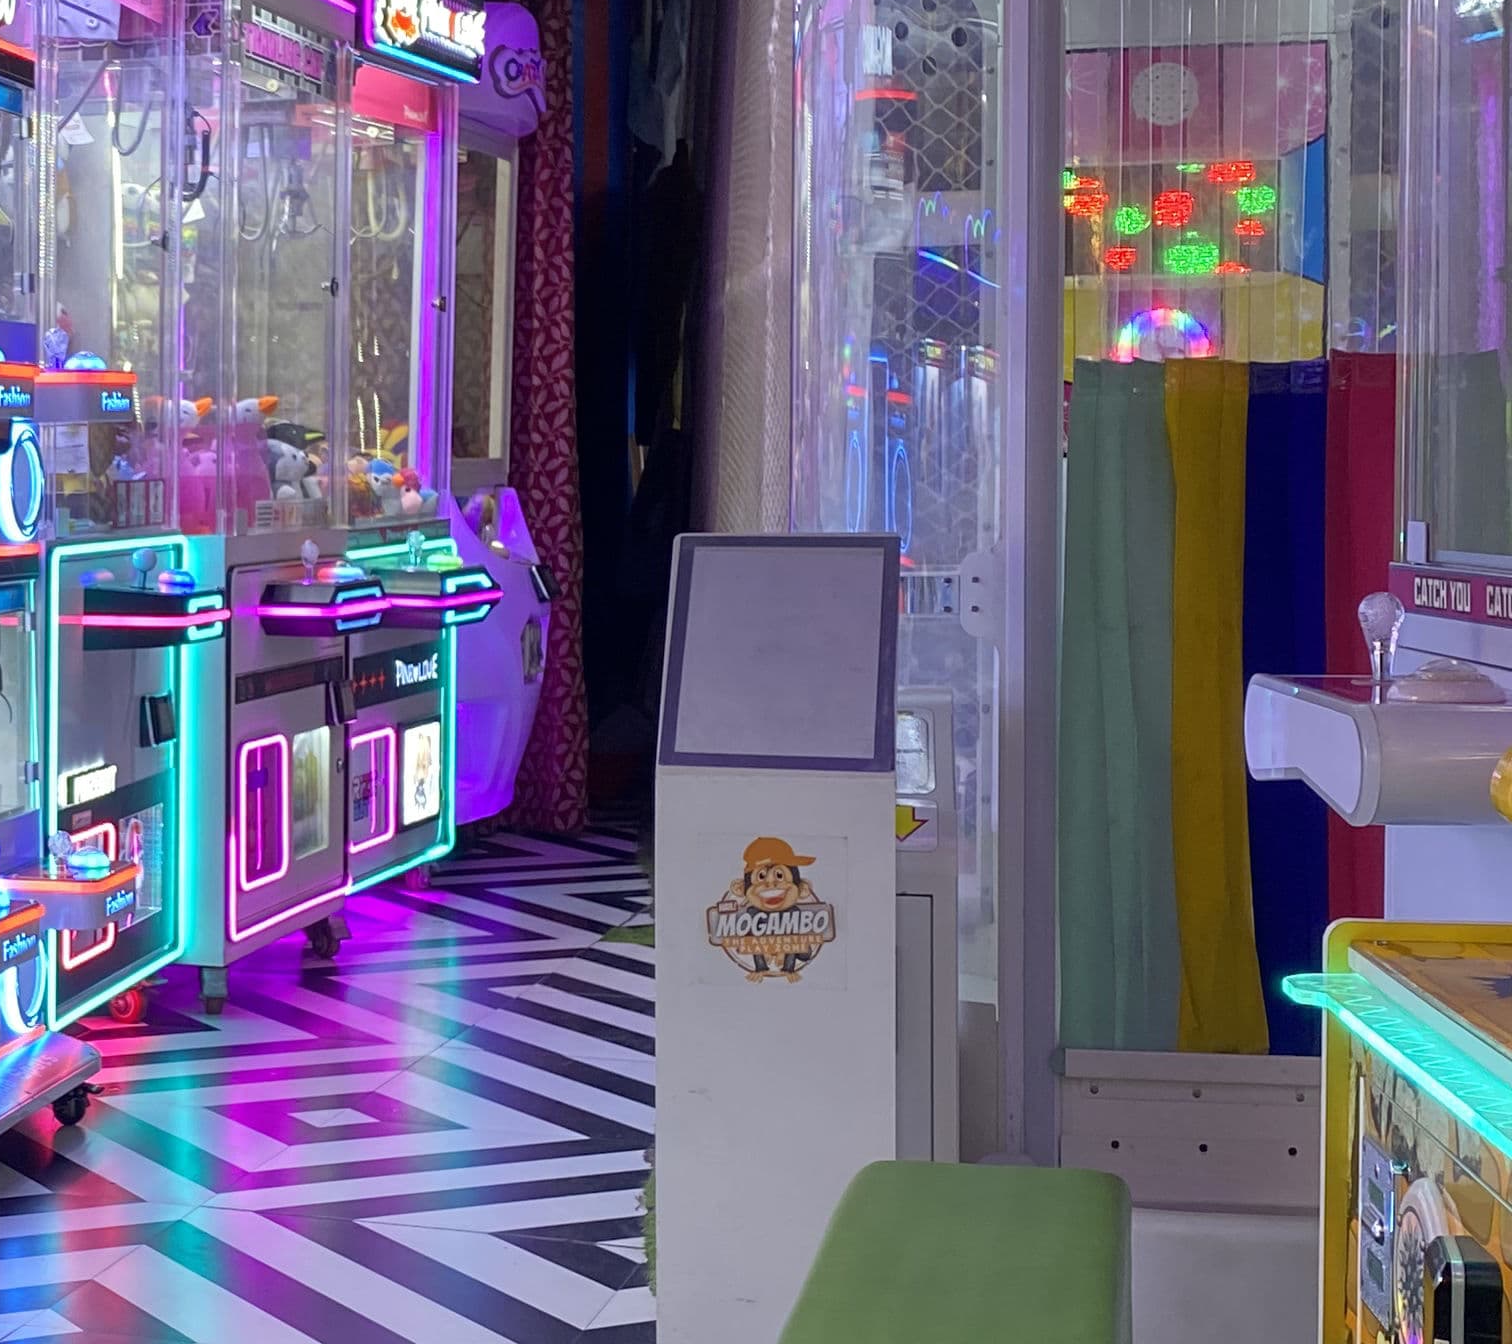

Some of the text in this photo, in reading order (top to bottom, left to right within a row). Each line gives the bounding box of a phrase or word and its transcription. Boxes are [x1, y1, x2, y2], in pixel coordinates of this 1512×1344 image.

[101, 391, 131, 412] Fashion
[1414, 576, 1447, 609] CATCH
[1450, 580, 1471, 613] YOU
[105, 890, 136, 917] Fashion
[716, 909, 828, 937] MOGAMBO
[3, 932, 37, 962] Fashion
